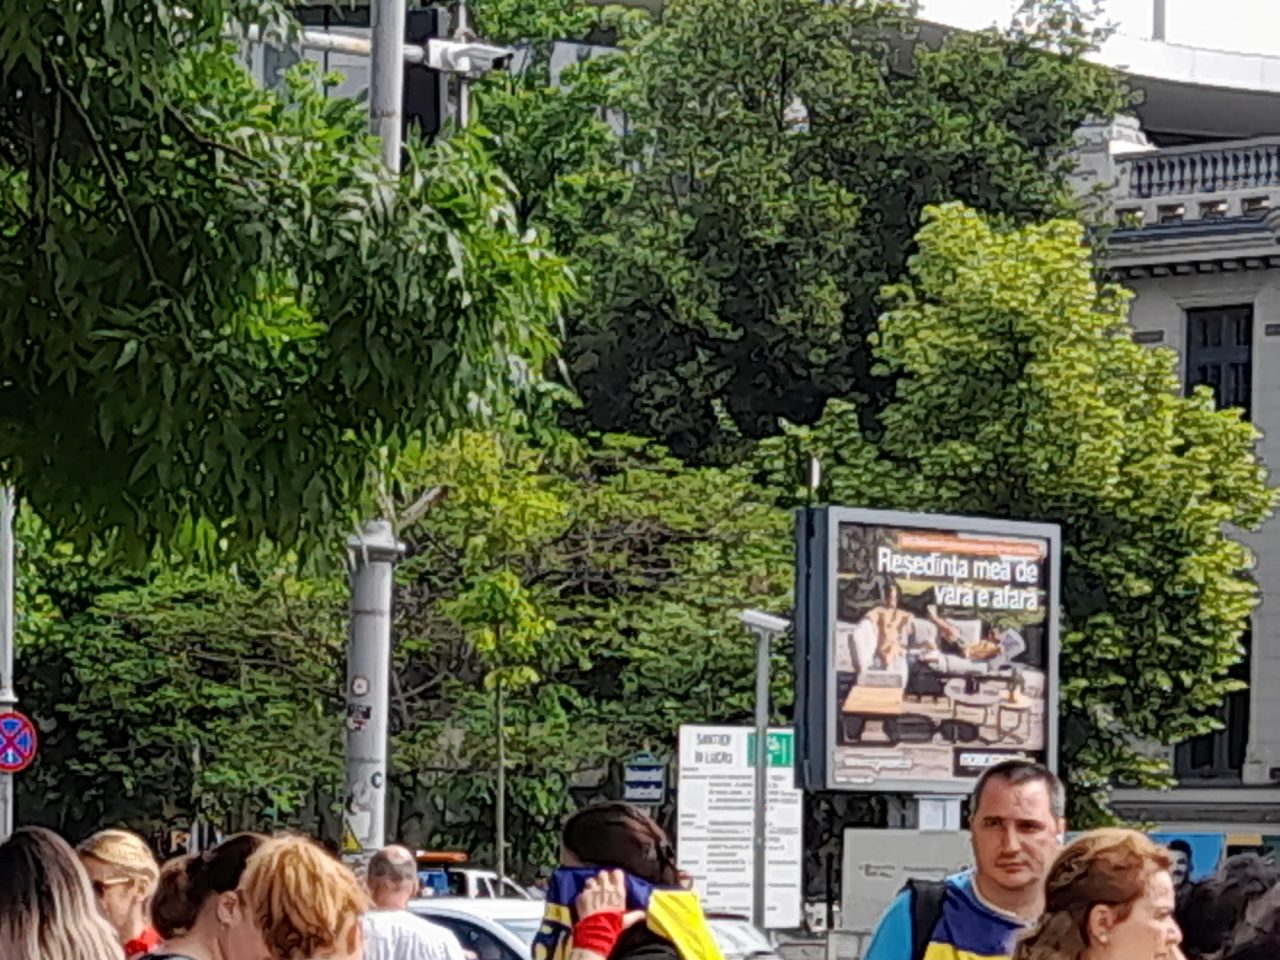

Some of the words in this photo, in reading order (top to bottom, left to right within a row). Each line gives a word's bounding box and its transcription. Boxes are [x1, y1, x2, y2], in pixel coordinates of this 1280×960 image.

[973, 561, 1011, 582] mea
[1015, 560, 1038, 583] de
[977, 591, 989, 604] e
